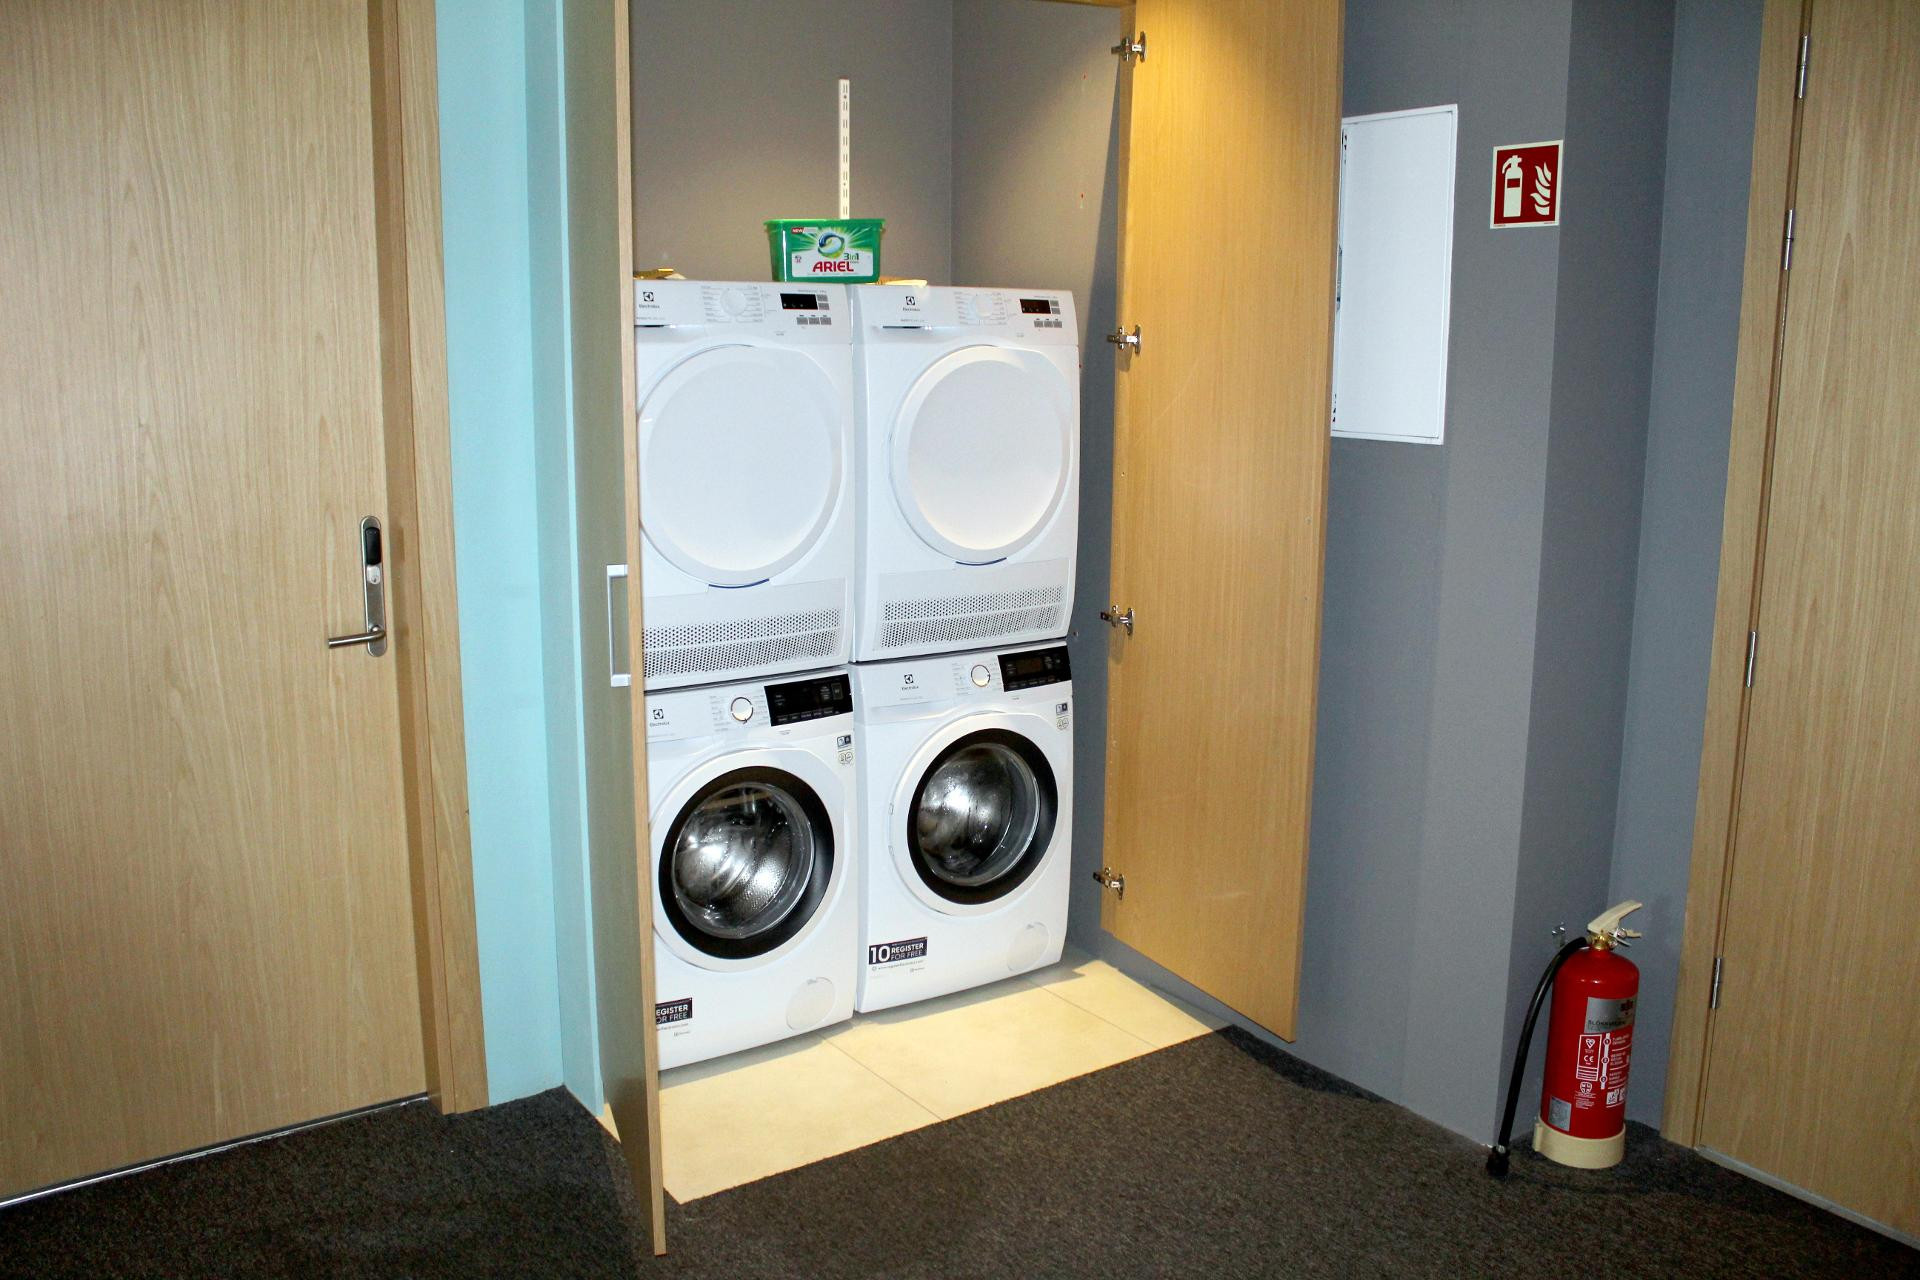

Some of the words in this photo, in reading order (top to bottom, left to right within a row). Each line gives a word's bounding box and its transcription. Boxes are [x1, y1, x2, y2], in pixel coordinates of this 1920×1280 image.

[844, 252, 860, 261] 3in1
[812, 261, 854, 272] ARIEL
[891, 942, 924, 954] REGISTER
[870, 945, 891, 964] 10
[890, 953, 906, 961] FOR
[907, 950, 923, 959] FREE
[656, 1004, 689, 1016] EGISTER
[669, 1012, 688, 1022] FREE
